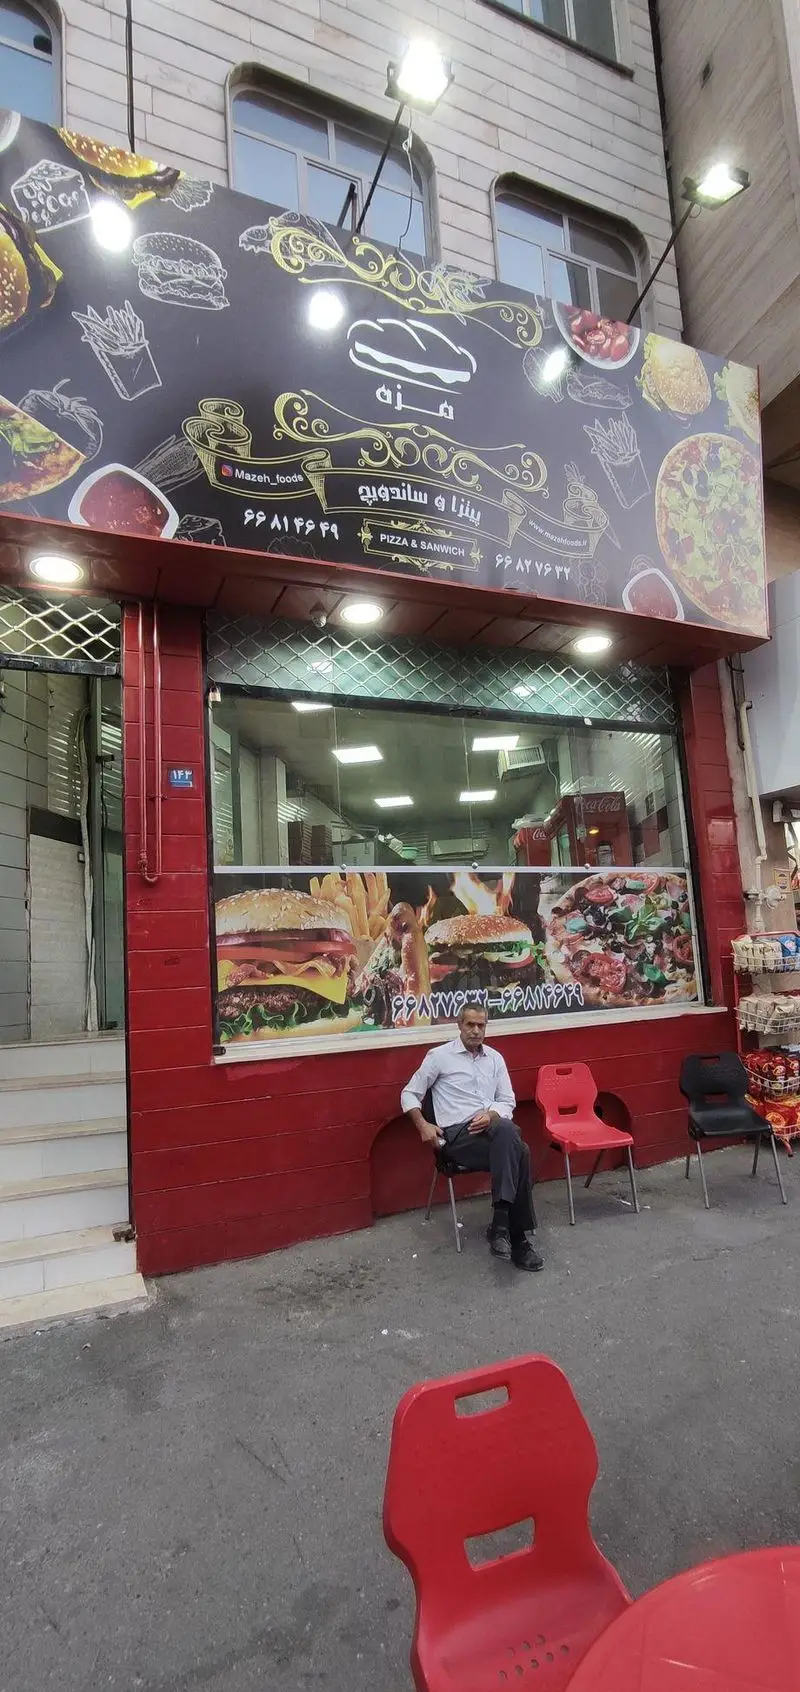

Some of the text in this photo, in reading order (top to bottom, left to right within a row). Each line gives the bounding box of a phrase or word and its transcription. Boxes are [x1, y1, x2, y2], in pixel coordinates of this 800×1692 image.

[234, 467, 304, 486] Mazeh_foods
[358, 481, 482, 527] پیتزا و ساندویچ
[380, 533, 466, 557] PIZZA & SANWICH
[173, 769, 193, 780] ۱۴۳
